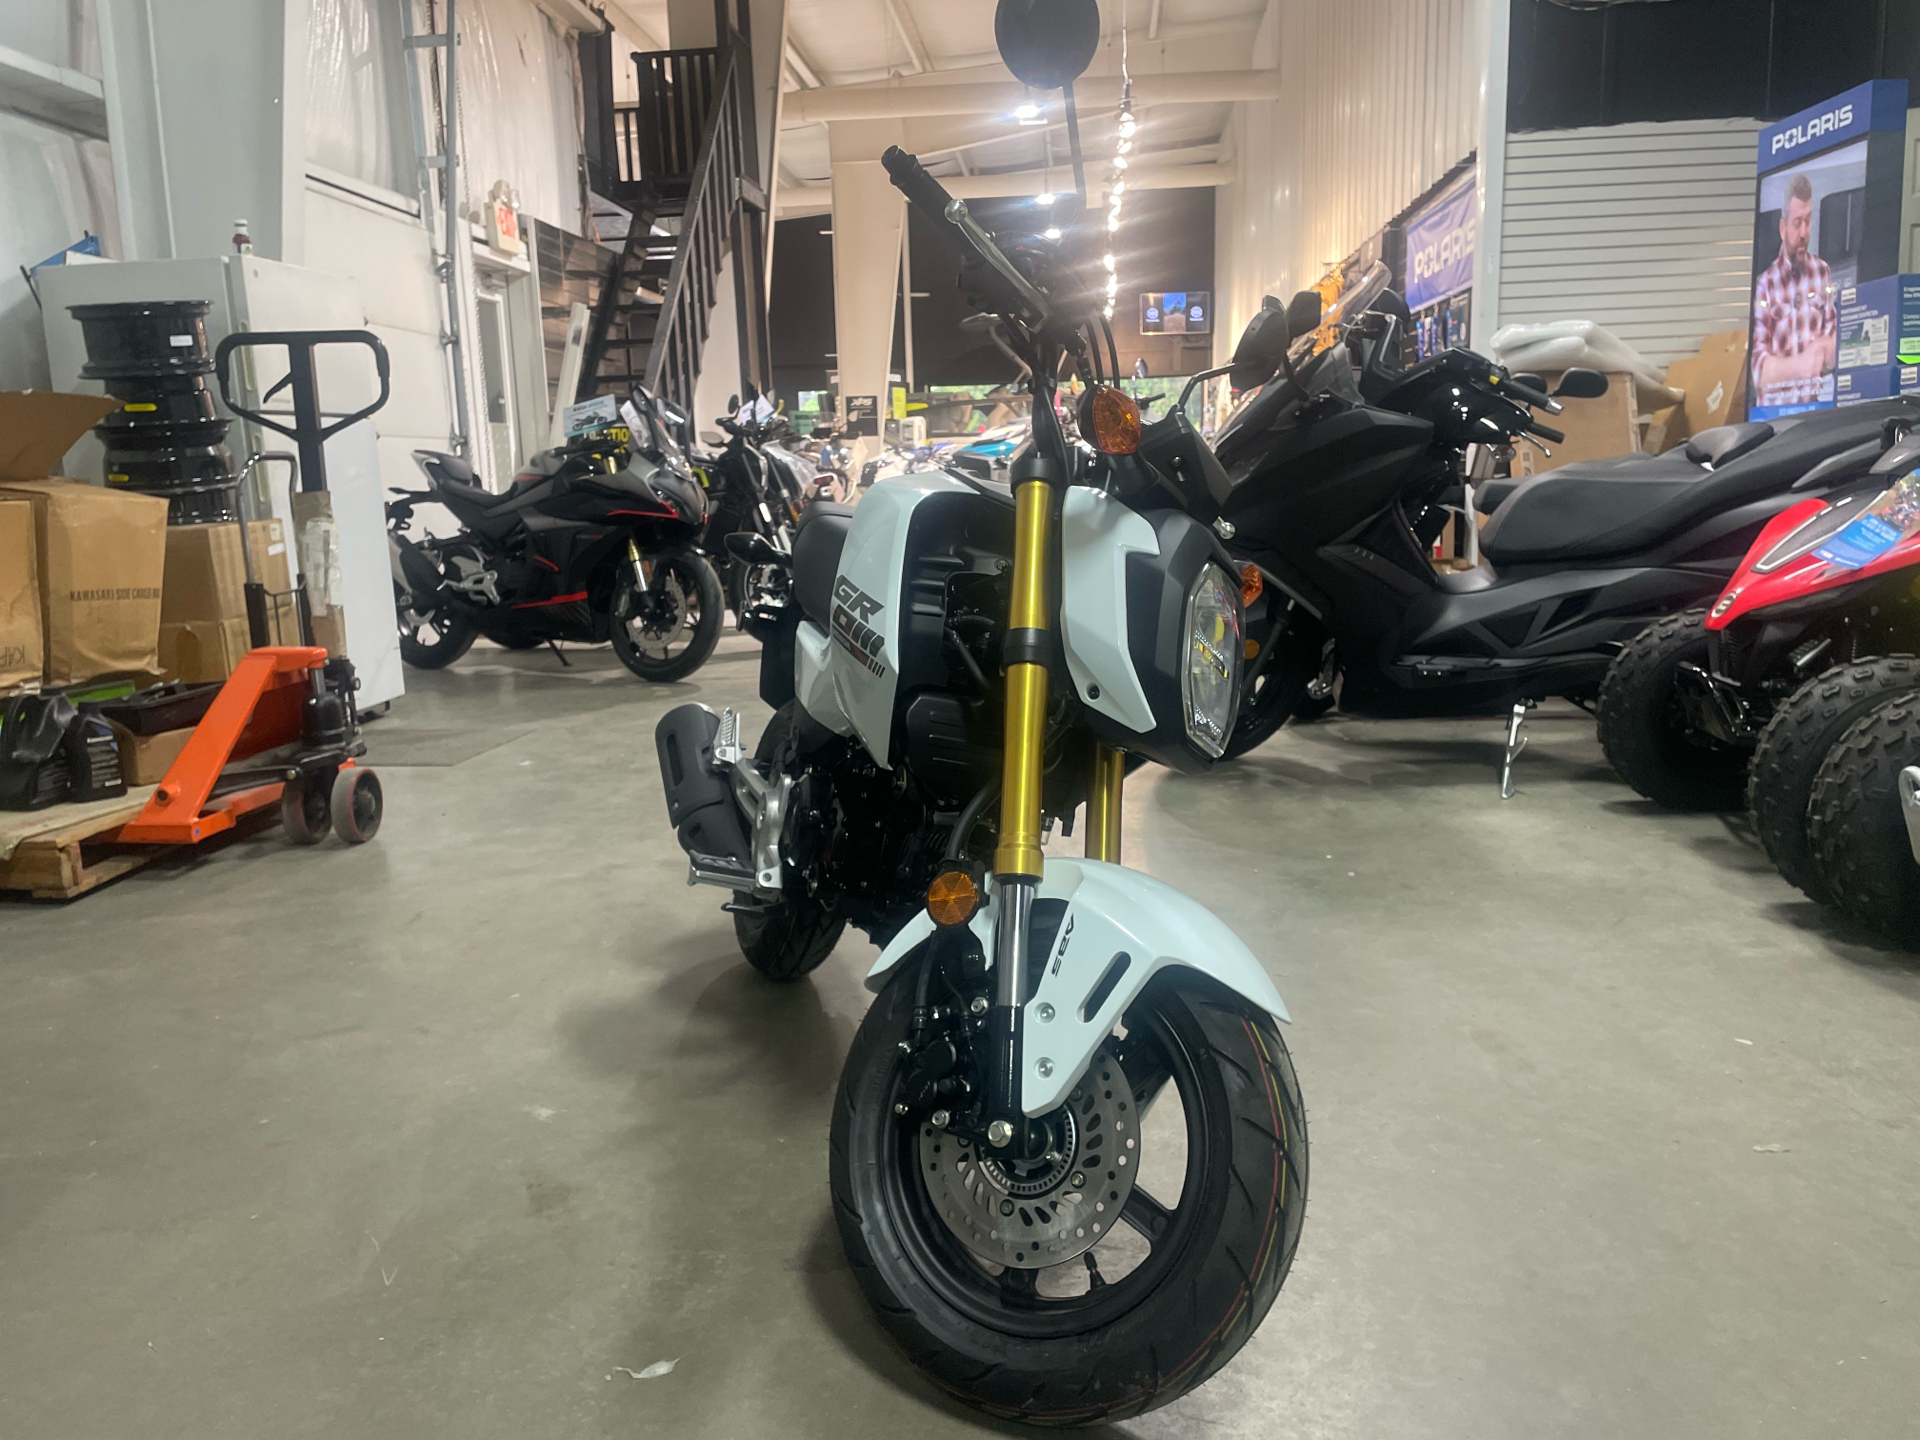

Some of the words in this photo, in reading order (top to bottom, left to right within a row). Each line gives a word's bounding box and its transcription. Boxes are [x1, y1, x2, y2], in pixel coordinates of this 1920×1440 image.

[1771, 104, 1853, 155] POLARIS
[1413, 218, 1475, 284] POLARIS
[70, 588, 115, 602] KAWASAKI
[834, 575, 885, 625] GR
[1051, 912, 1074, 978] ABS
